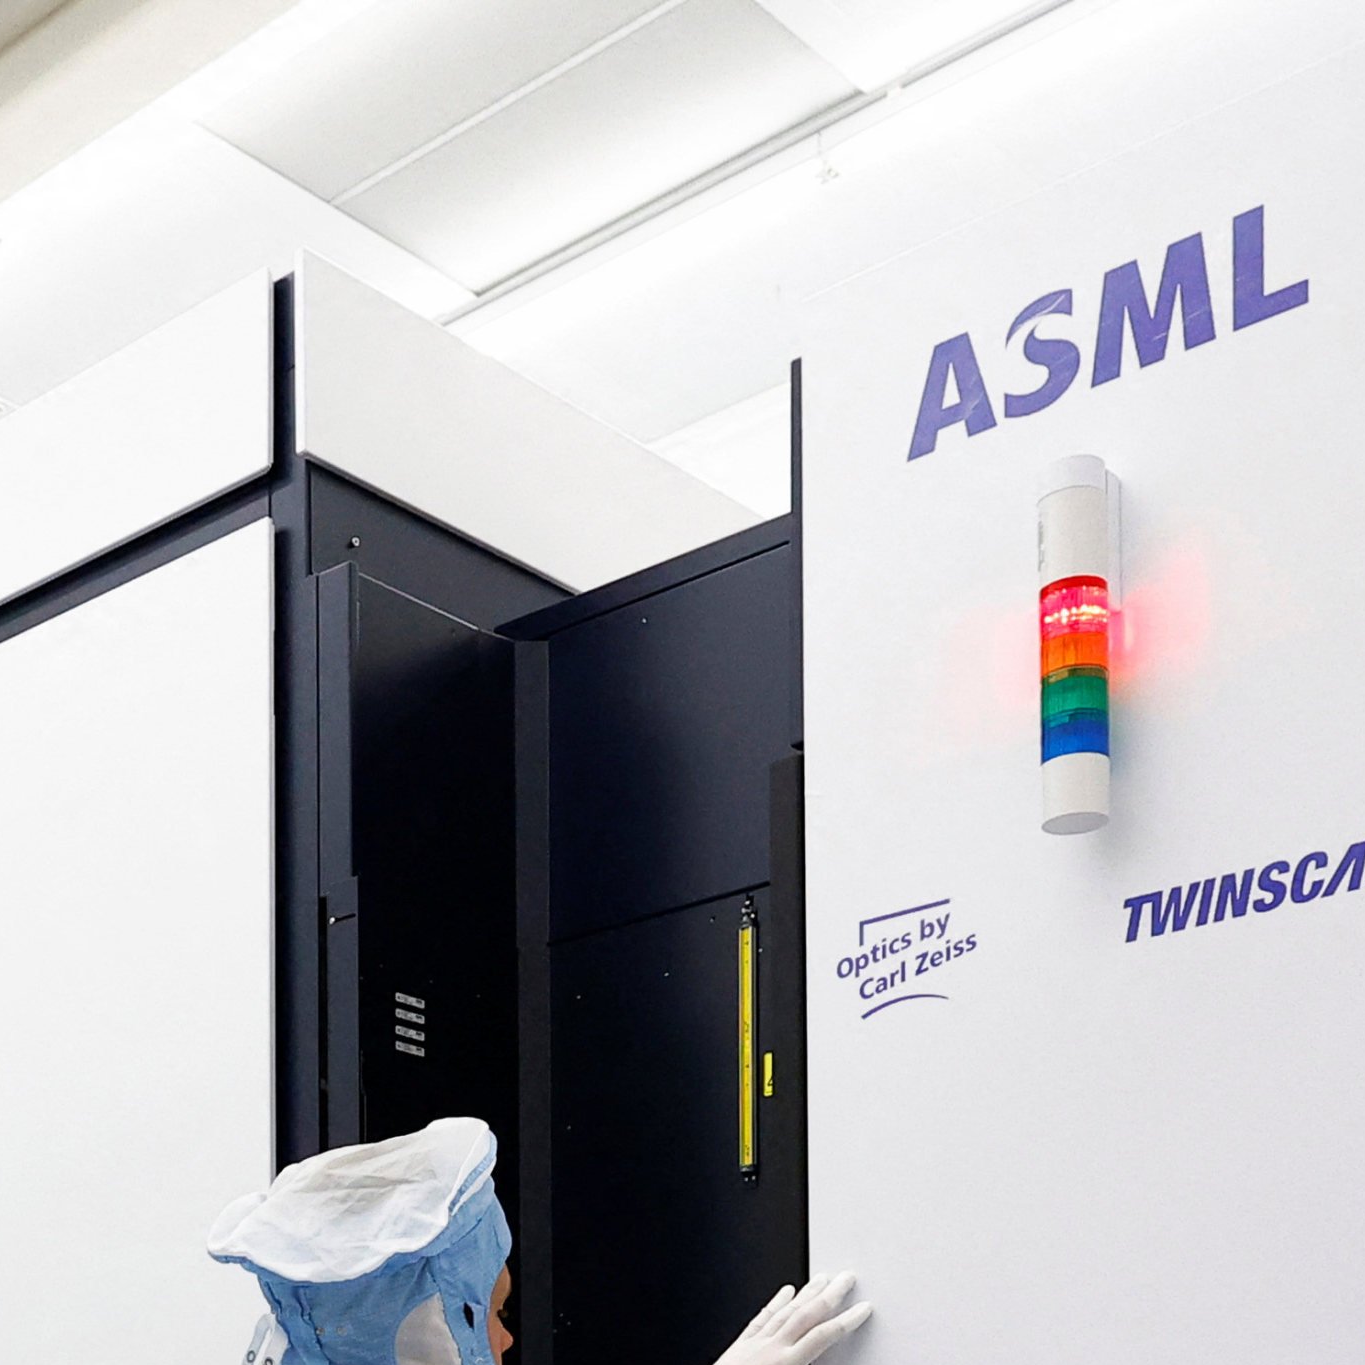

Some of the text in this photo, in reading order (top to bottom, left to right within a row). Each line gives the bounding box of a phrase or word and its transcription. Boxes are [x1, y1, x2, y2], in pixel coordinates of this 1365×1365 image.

[906, 204, 1310, 463] ASML
[837, 912, 951, 979] Optics by
[859, 933, 978, 1000] Carl Zeiss
